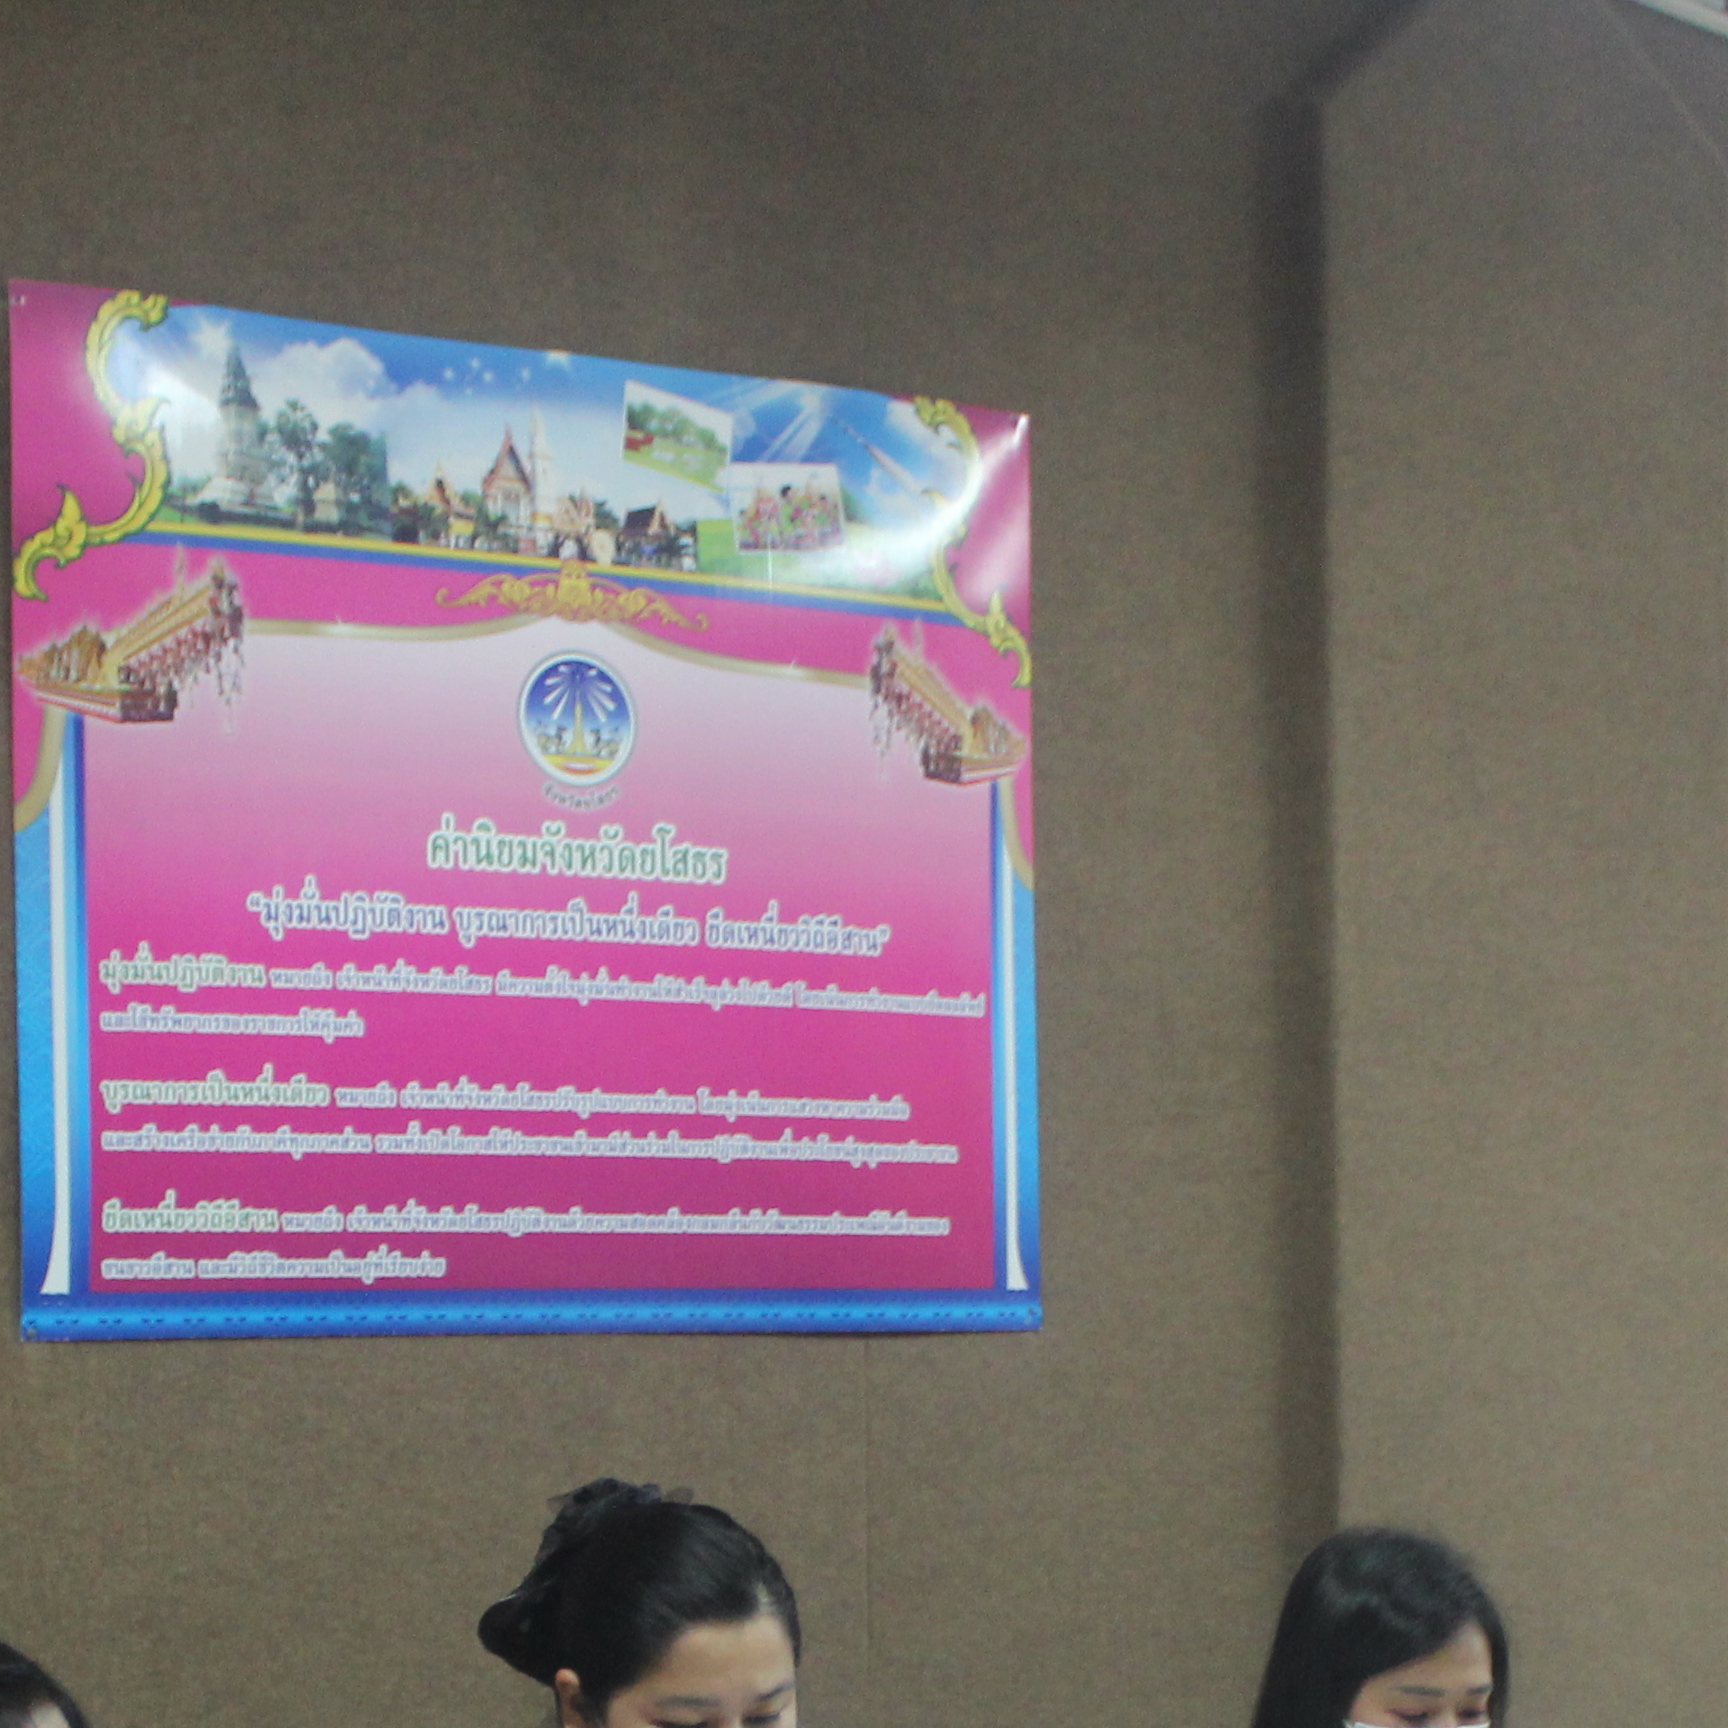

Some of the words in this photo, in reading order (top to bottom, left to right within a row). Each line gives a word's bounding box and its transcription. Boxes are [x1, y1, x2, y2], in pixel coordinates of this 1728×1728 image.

[428, 815, 727, 883] ค่านิยมจังหวัดยโสธร
[249, 876, 447, 939] “มุ่งมั่นปฏิบัติงาน
[454, 894, 698, 947] บูรณาการเป็นหนึ่งเดียว
[100, 943, 266, 993] มุ่งมั่นปฏิบัติงาน
[100, 1064, 330, 1114] บูรณาการเป็นหนึ่งเดียว
